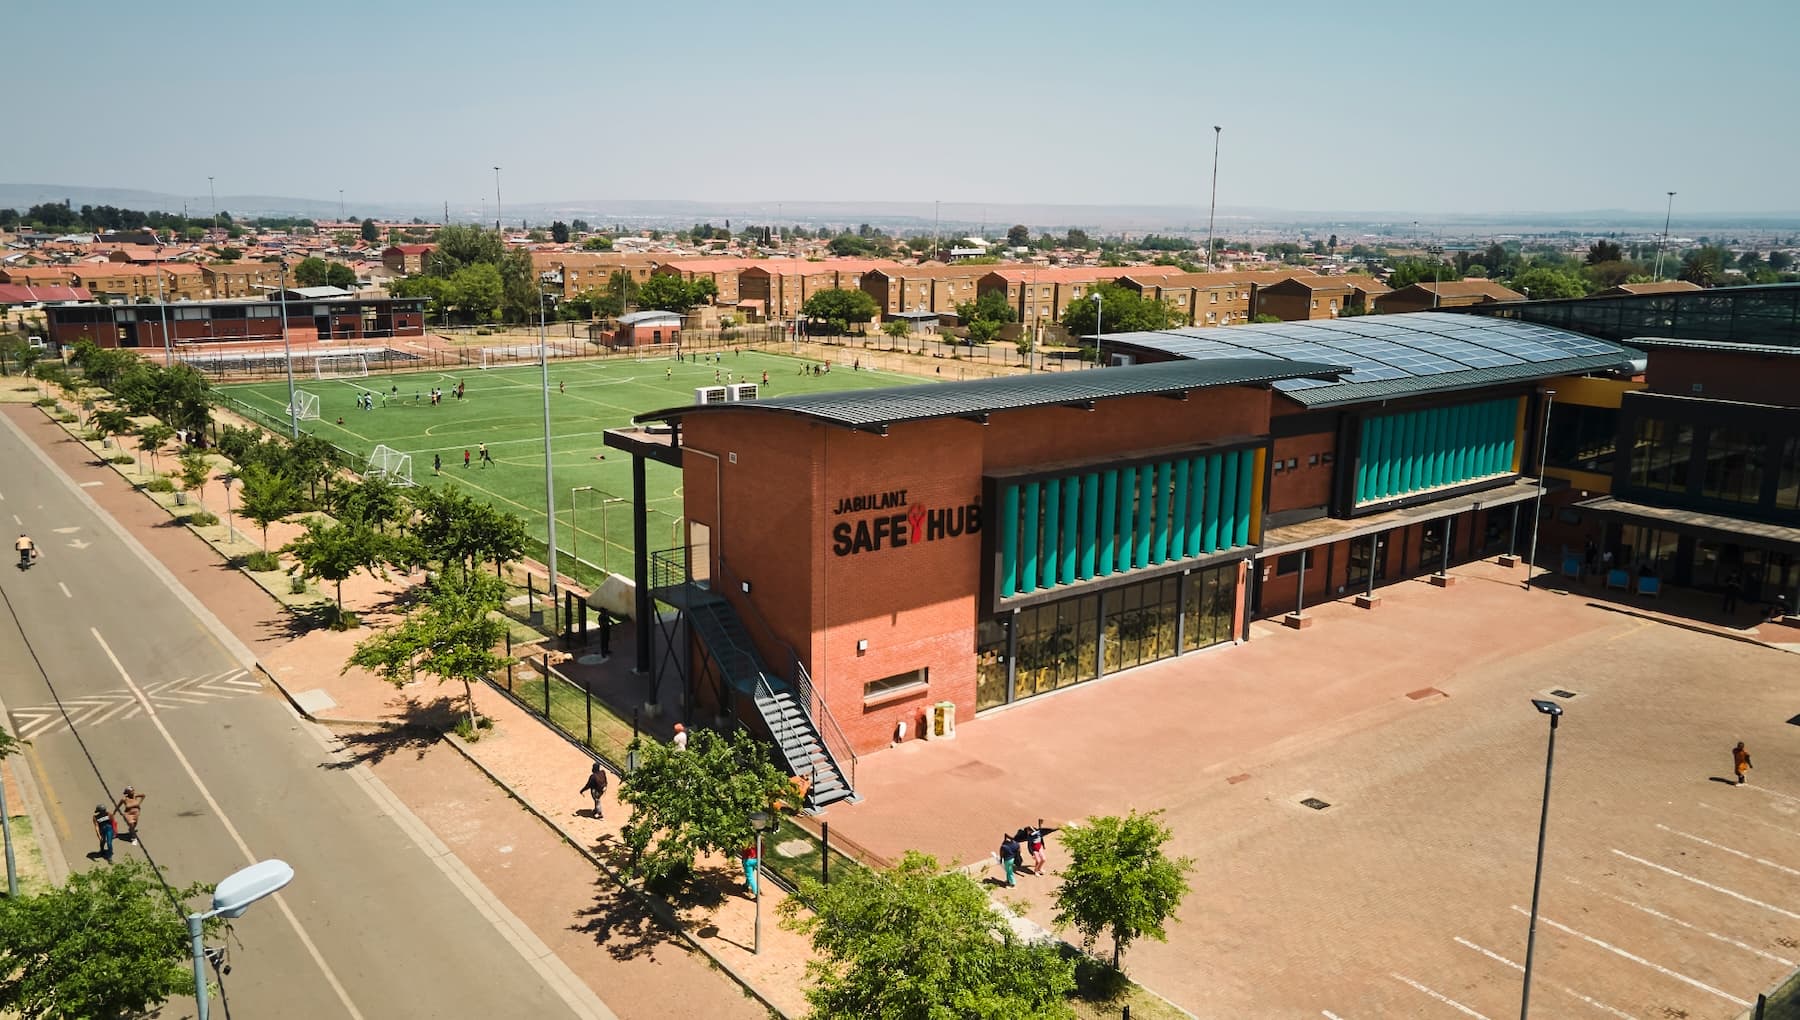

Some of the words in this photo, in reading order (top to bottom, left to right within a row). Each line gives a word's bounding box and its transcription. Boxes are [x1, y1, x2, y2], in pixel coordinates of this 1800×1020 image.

[833, 490, 908, 515] JABULANI
[832, 514, 908, 557] SAFE
[927, 504, 983, 541] HUB
